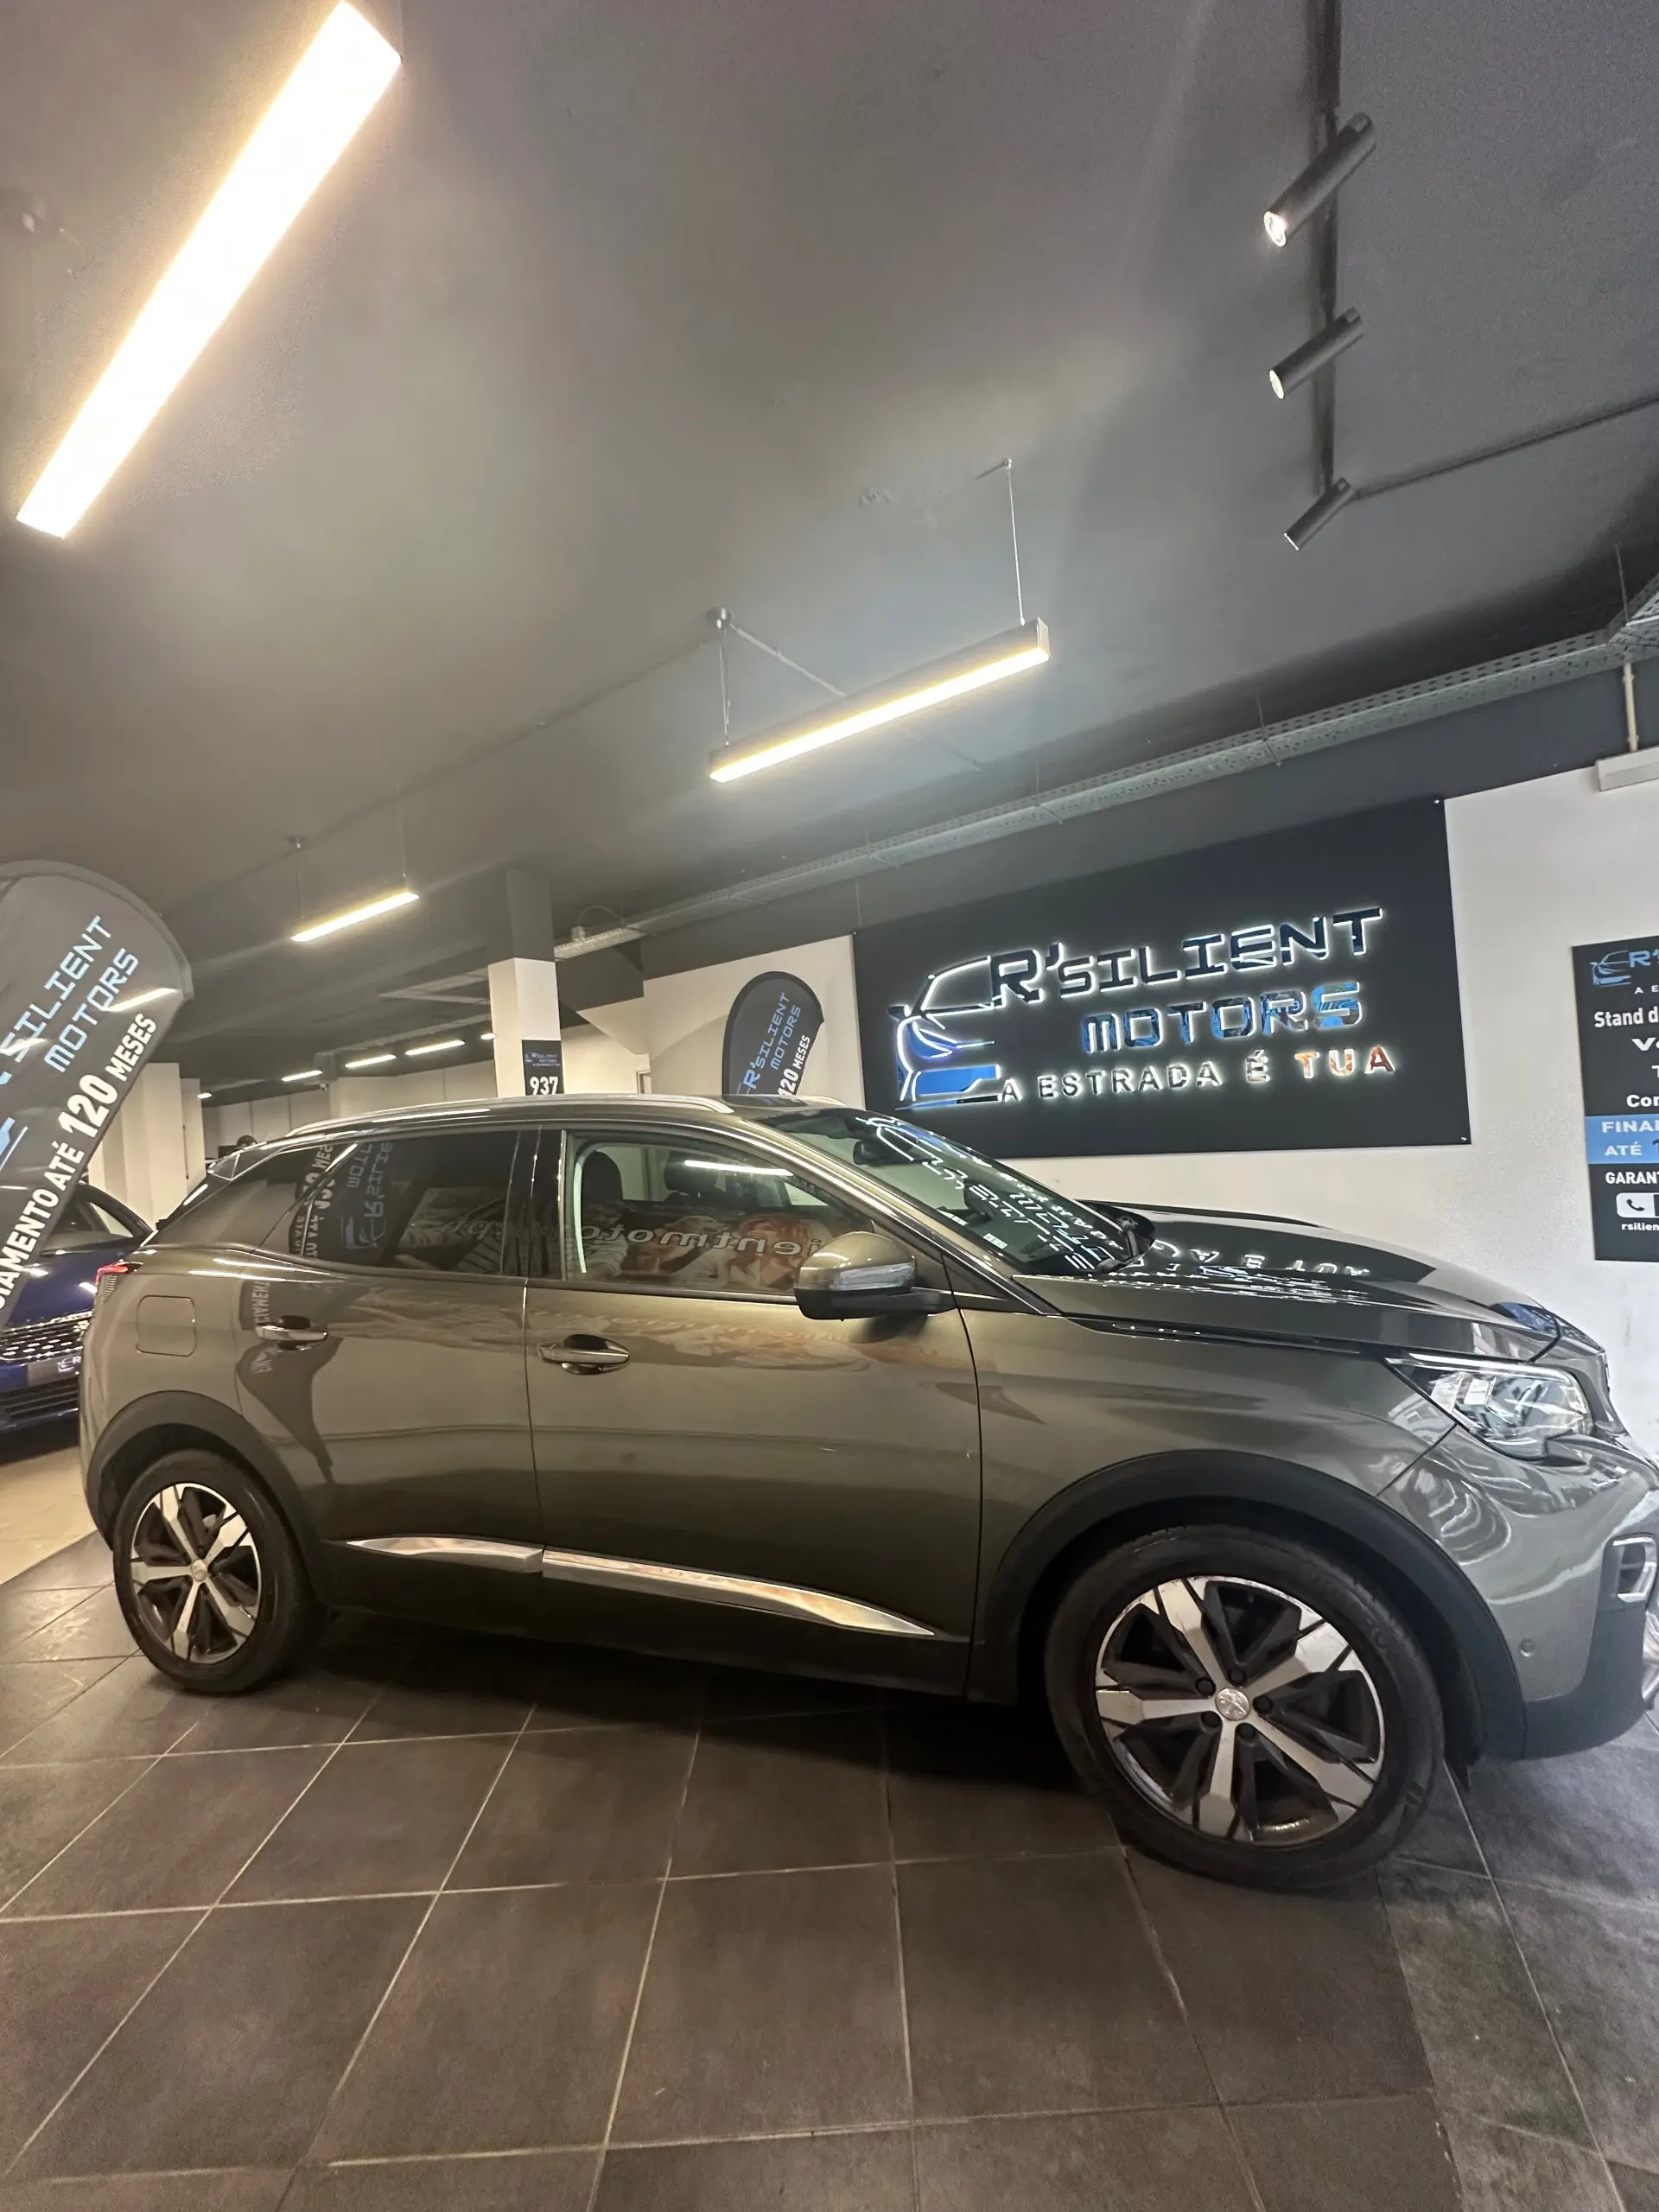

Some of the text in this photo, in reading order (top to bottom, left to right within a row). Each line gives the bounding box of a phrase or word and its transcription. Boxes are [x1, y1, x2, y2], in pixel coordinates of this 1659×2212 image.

[990, 907, 1383, 1009] R'SILIENT
[0, 915, 111, 1085] SILIENT
[44, 947, 139, 1072] MOTORS
[1082, 982, 1363, 1054] MOTORS
[1594, 1007, 1644, 1027] Stand
[743, 992, 790, 1089] R'SILIENT
[770, 1005, 801, 1071] MOTORS
[792, 1034, 810, 1070] MESES
[530, 1076, 559, 1095] 937
[1002, 1044, 1396, 1102] A ESTRADA É TUA
[0, 1013, 156, 1309] IAMENTO ATÉ 120 MESES
[1604, 1141, 1643, 1156] ATÉ
